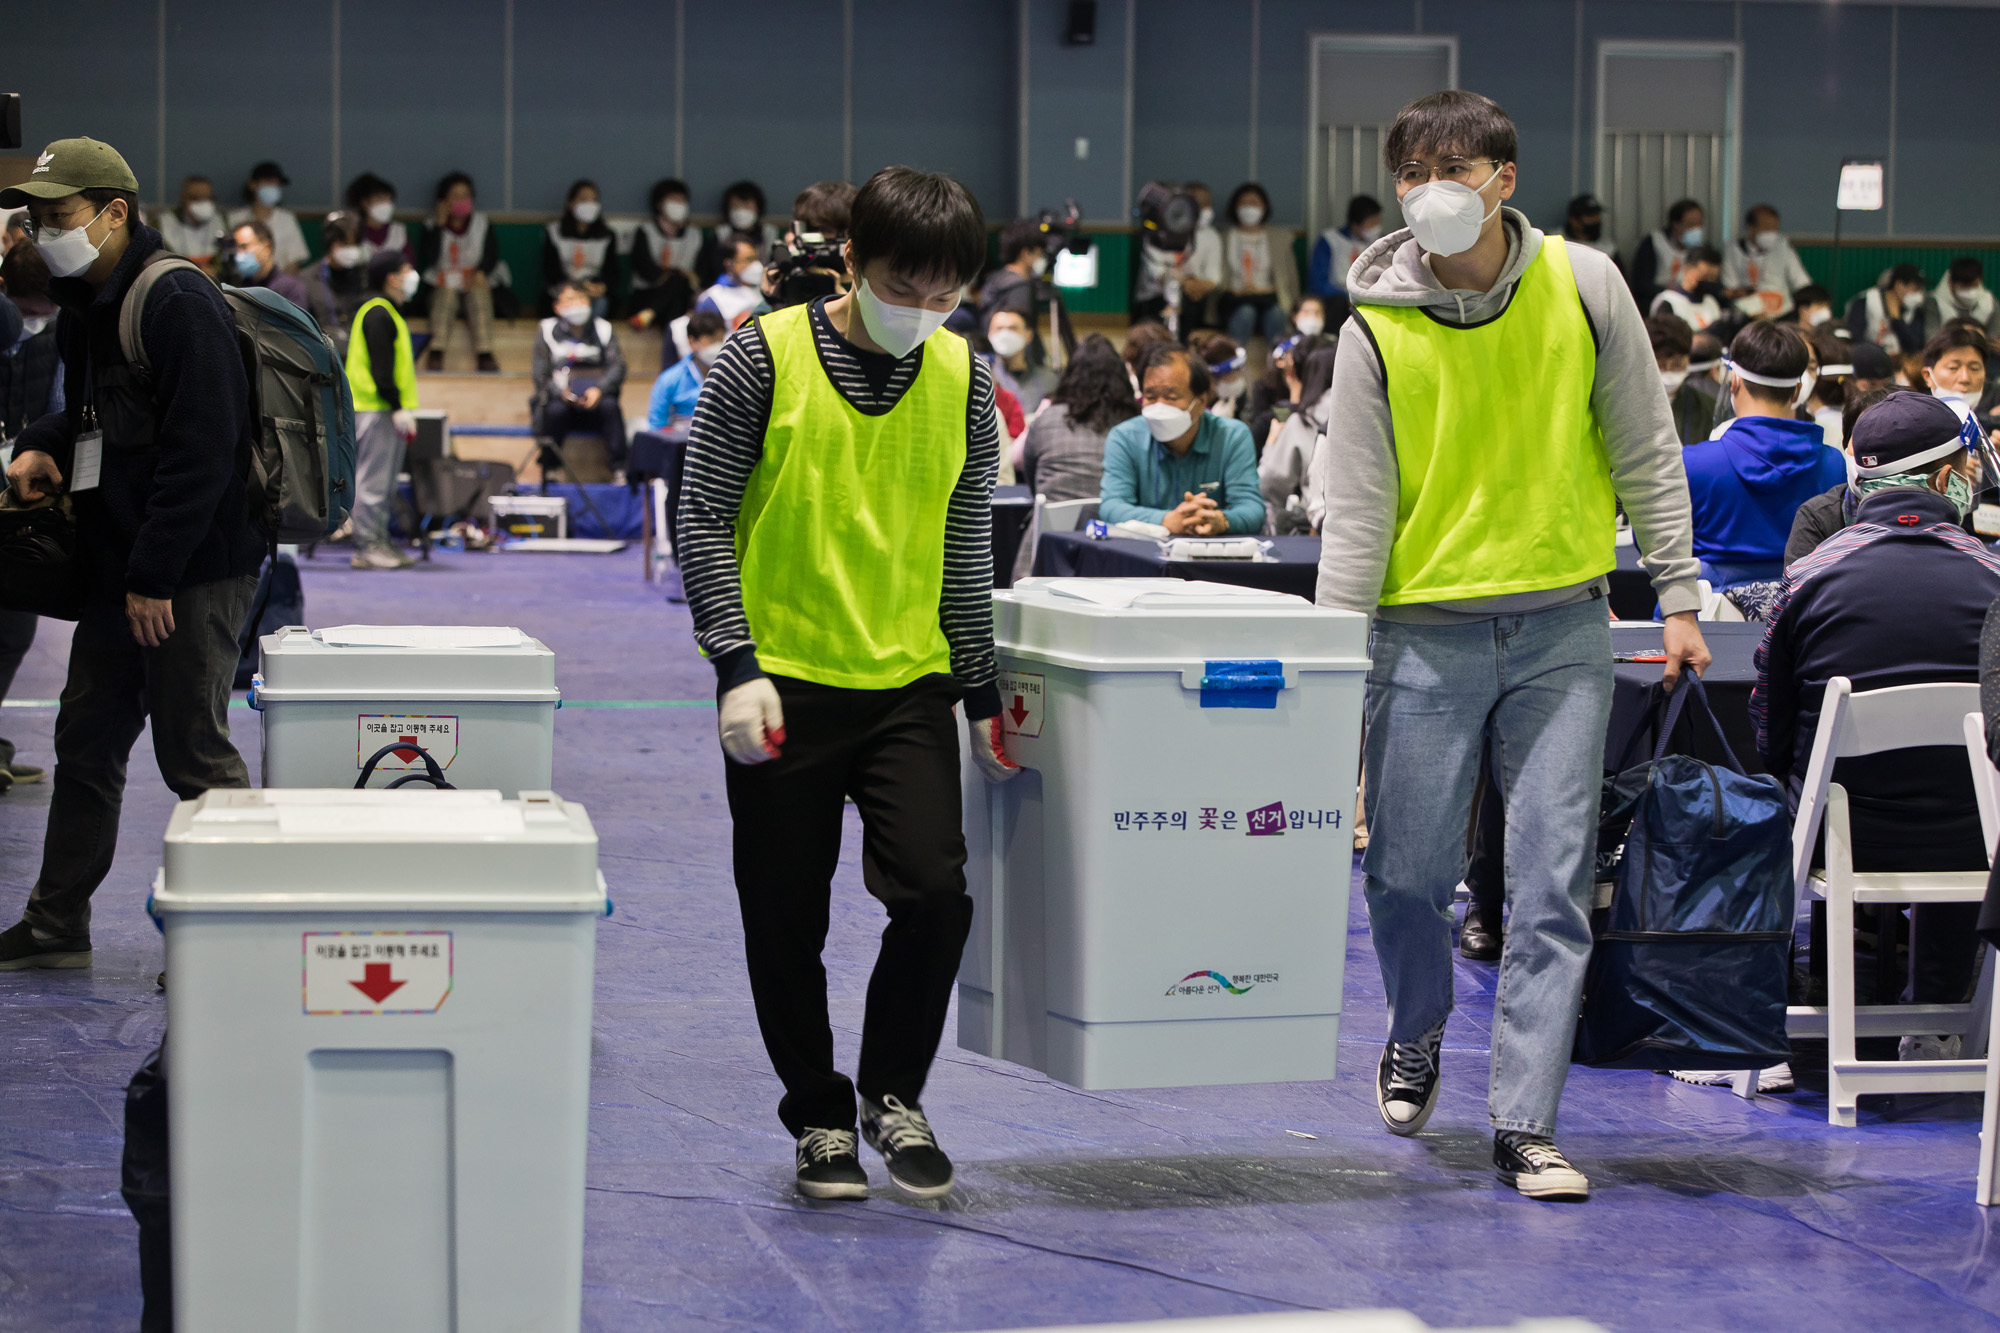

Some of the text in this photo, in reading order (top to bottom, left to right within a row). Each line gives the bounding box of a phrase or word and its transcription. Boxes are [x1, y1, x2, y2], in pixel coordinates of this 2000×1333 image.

[366, 723, 450, 734] 이곳을 잡고 이동해 주세요
[1113, 810, 1188, 831] 민주주의
[1198, 807, 1238, 831] 꽃은
[1232, 973, 1279, 984] 행복한 대한민국
[1178, 985, 1220, 995] 아름다운 선거
